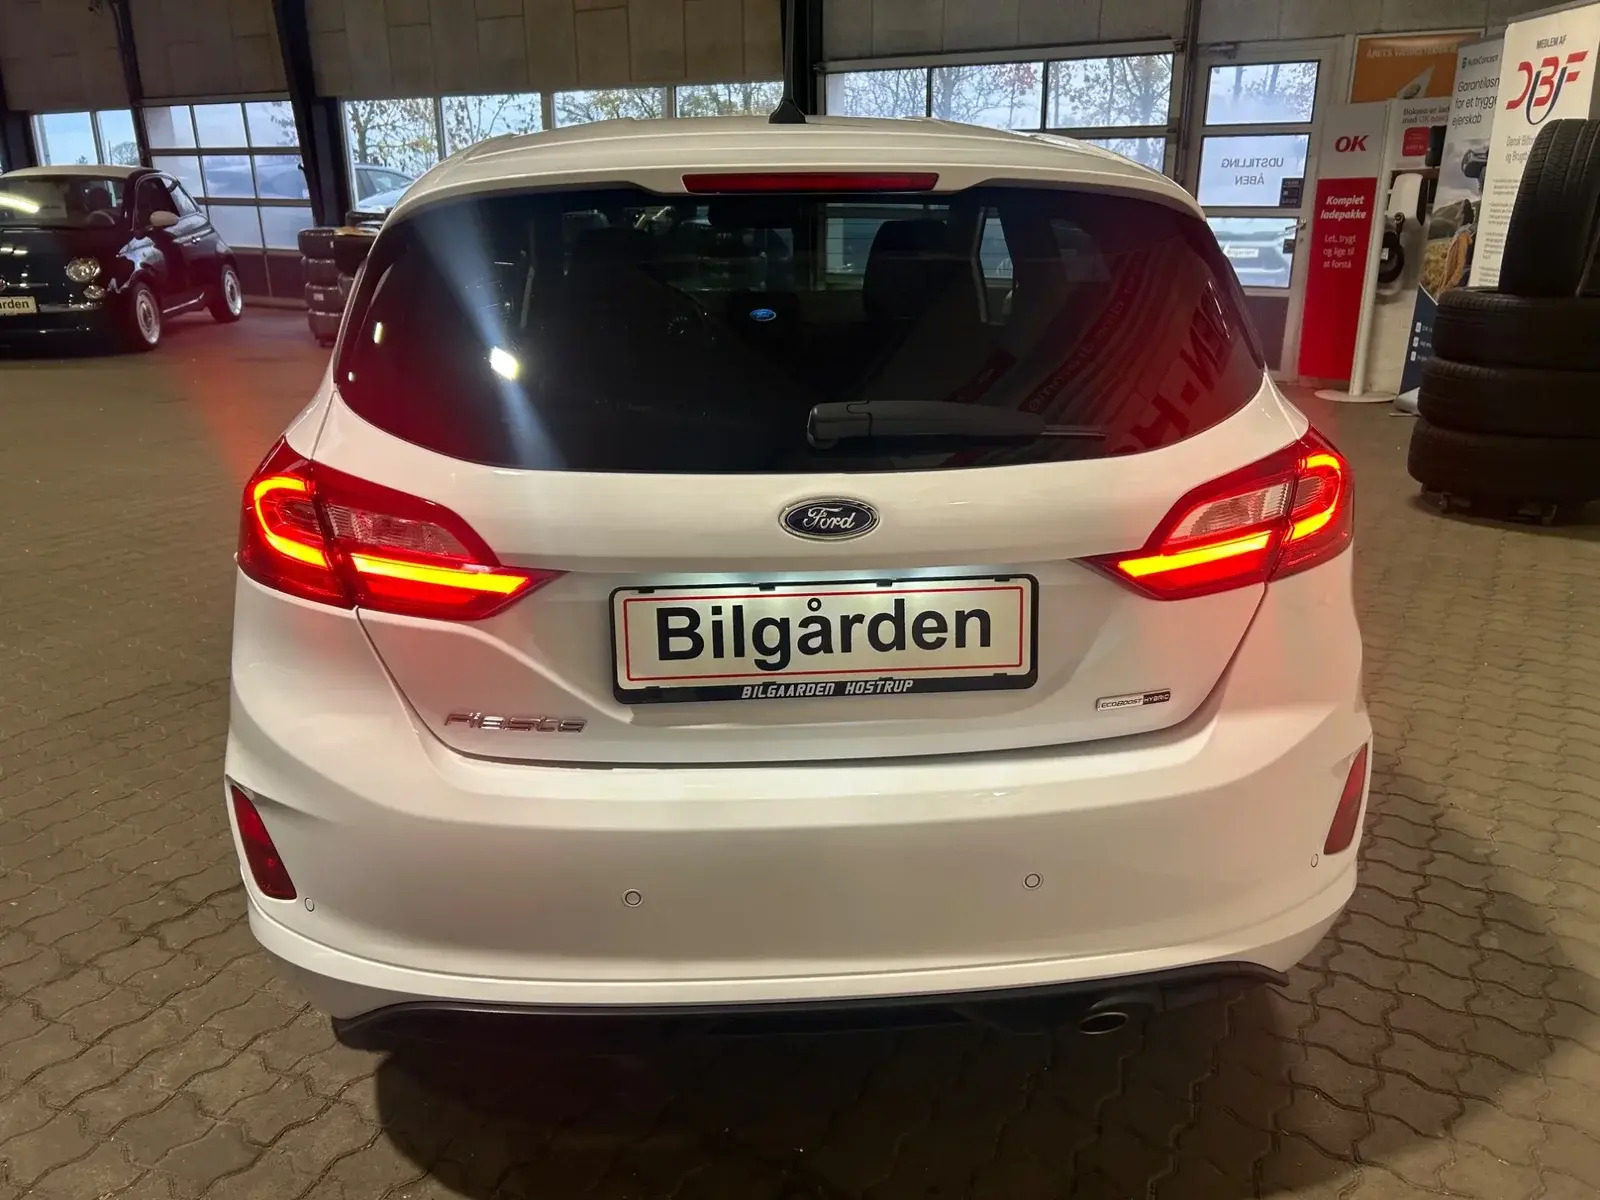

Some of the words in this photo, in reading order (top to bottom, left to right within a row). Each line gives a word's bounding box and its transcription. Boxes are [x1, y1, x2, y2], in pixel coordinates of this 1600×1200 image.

[1536, 36, 1559, 49] MEDLEM
[1559, 34, 1568, 45] AF
[1455, 100, 1465, 110] for
[1465, 97, 1474, 108] et
[1452, 112, 1482, 129] ejerskab
[1335, 135, 1369, 153] OK
[1325, 194, 1365, 208] Komplet
[1320, 209, 1367, 222] ladepakke
[1323, 248, 1333, 257] og
[803, 506, 857, 530] Ford
[655, 597, 992, 671] Bilgården
[741, 681, 835, 699] BILGAARDEN
[845, 679, 913, 695] HOSTRUP
[444, 711, 587, 733] Fiesta
